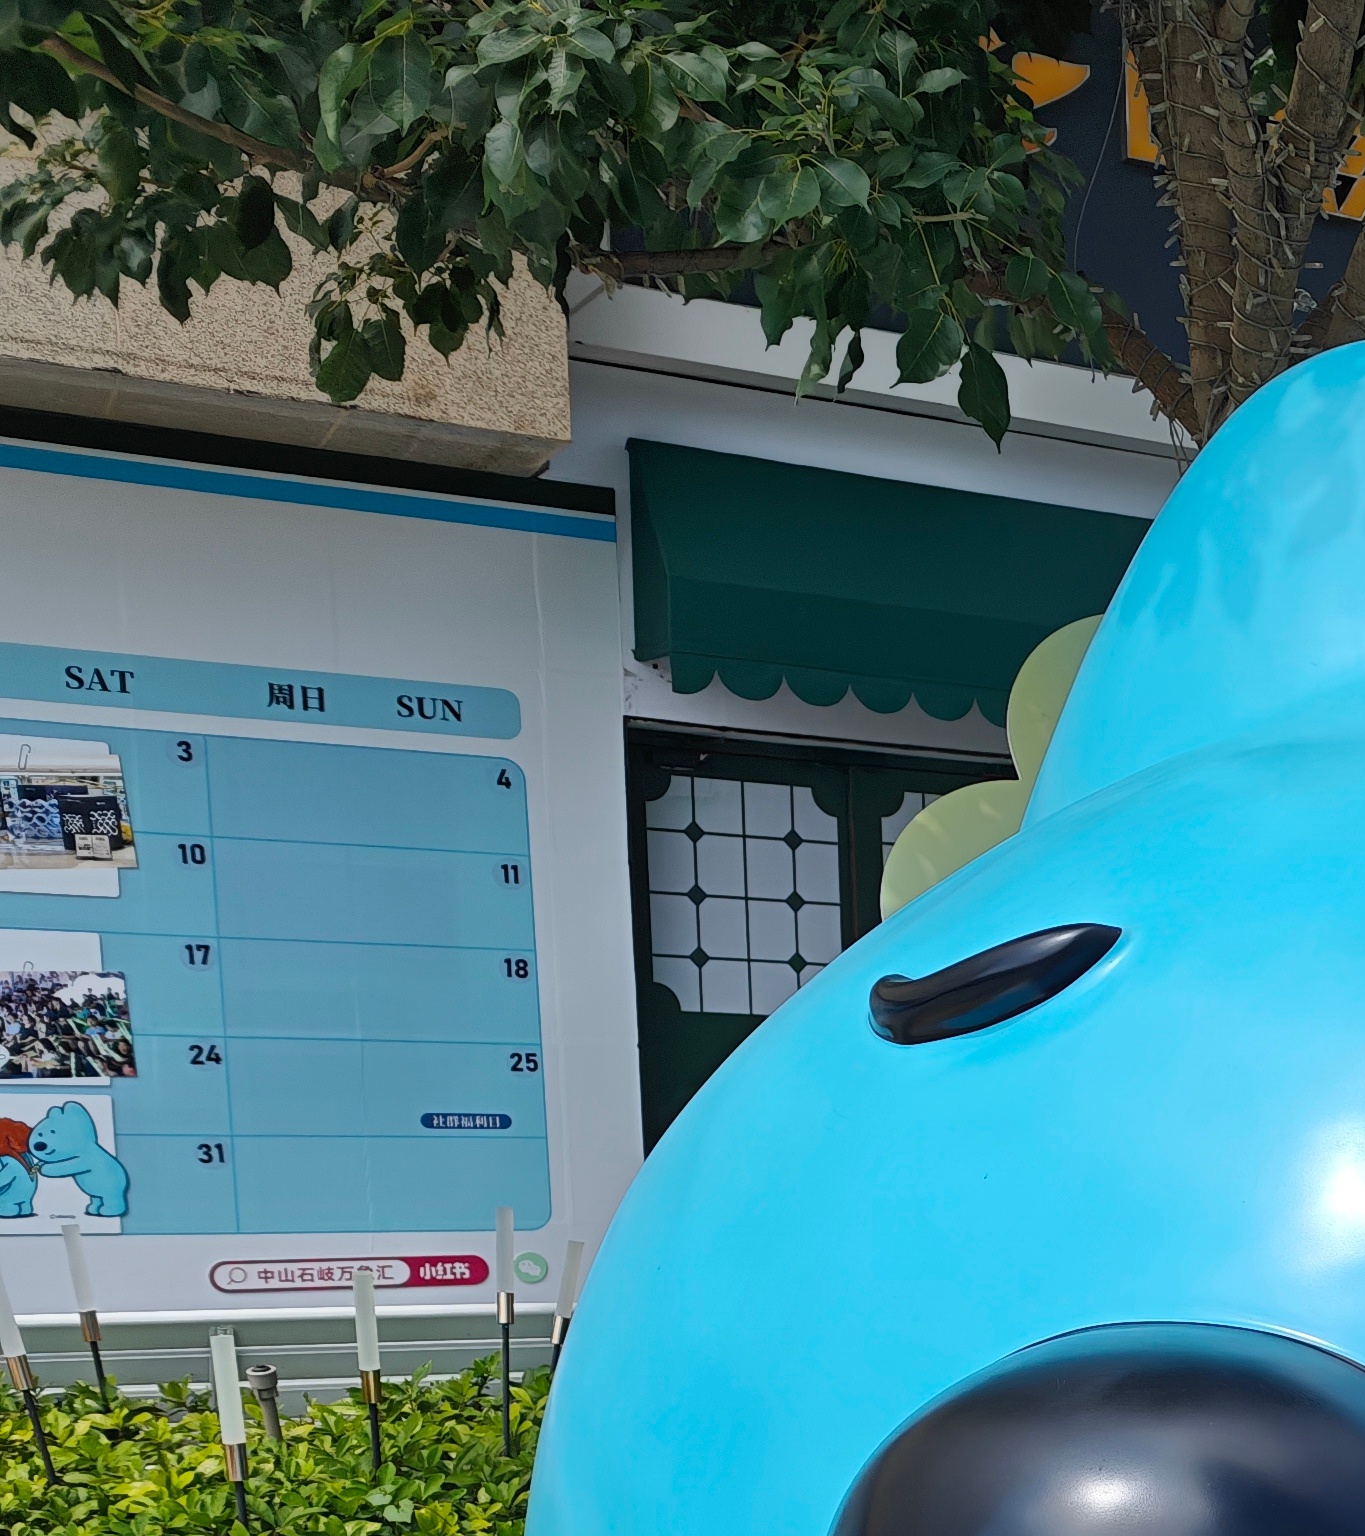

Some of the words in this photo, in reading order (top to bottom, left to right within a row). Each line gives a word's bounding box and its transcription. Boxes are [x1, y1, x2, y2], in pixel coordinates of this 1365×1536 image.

[64, 664, 135, 695] SAT
[266, 682, 327, 714] 周日
[395, 694, 464, 724] SUN
[177, 740, 193, 763] 3
[497, 769, 512, 790] 4
[177, 843, 206, 866] 10
[500, 864, 520, 886] 11
[185, 944, 210, 968] 17
[503, 958, 529, 980] 18
[189, 1044, 222, 1066] 24
[509, 1052, 539, 1074] 25
[197, 1143, 225, 1165] 31
[419, 1261, 472, 1281] 小红书
